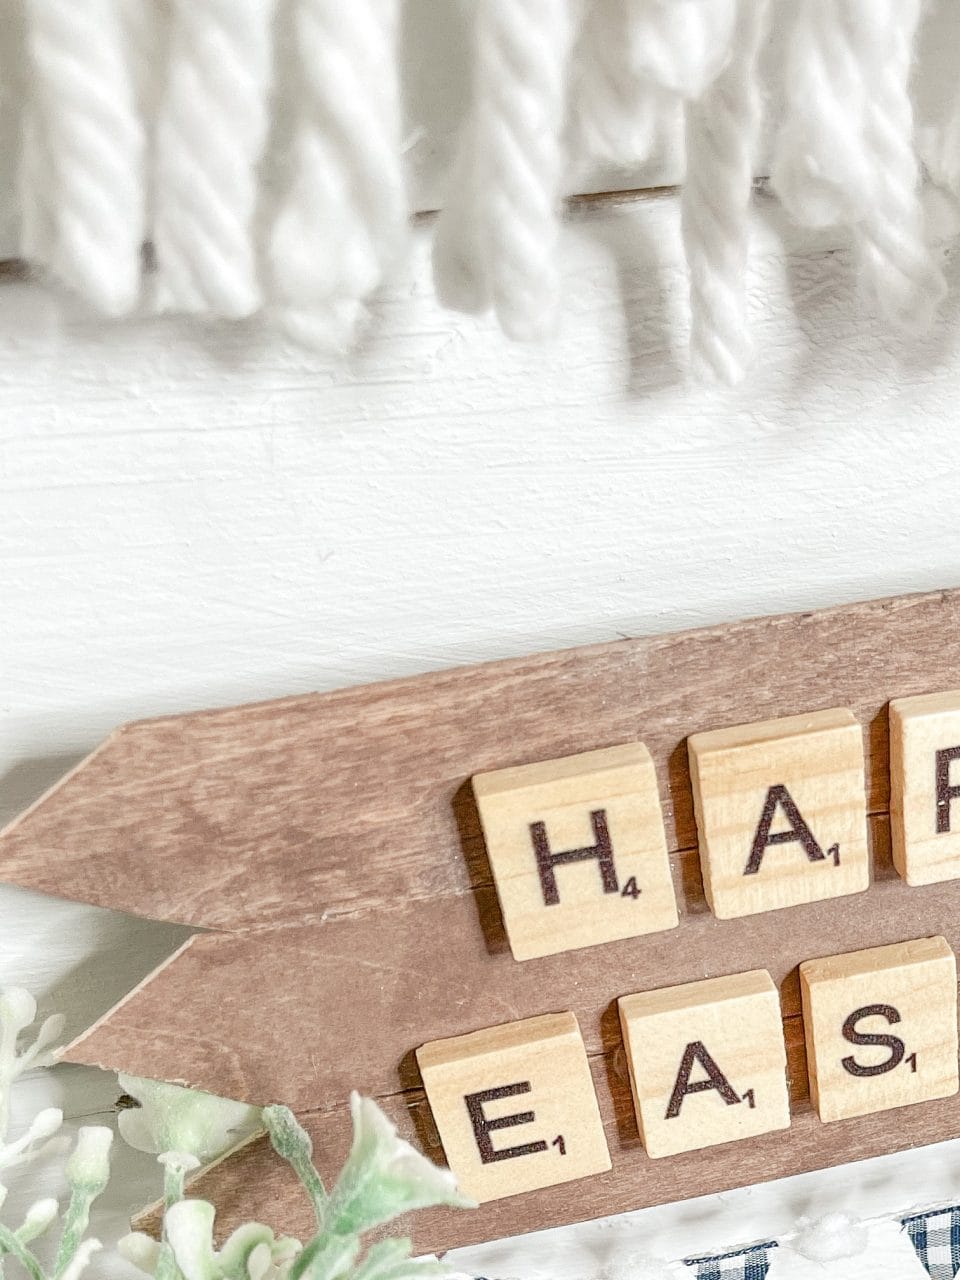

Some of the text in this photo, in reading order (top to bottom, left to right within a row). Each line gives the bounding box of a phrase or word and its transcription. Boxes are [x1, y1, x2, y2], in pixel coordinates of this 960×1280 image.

[827, 842, 841, 867] 1
[620, 875, 642, 901] 4
[904, 1052, 918, 1073] 1
[741, 1088, 756, 1109] 1
[551, 1134, 567, 1157] 1
